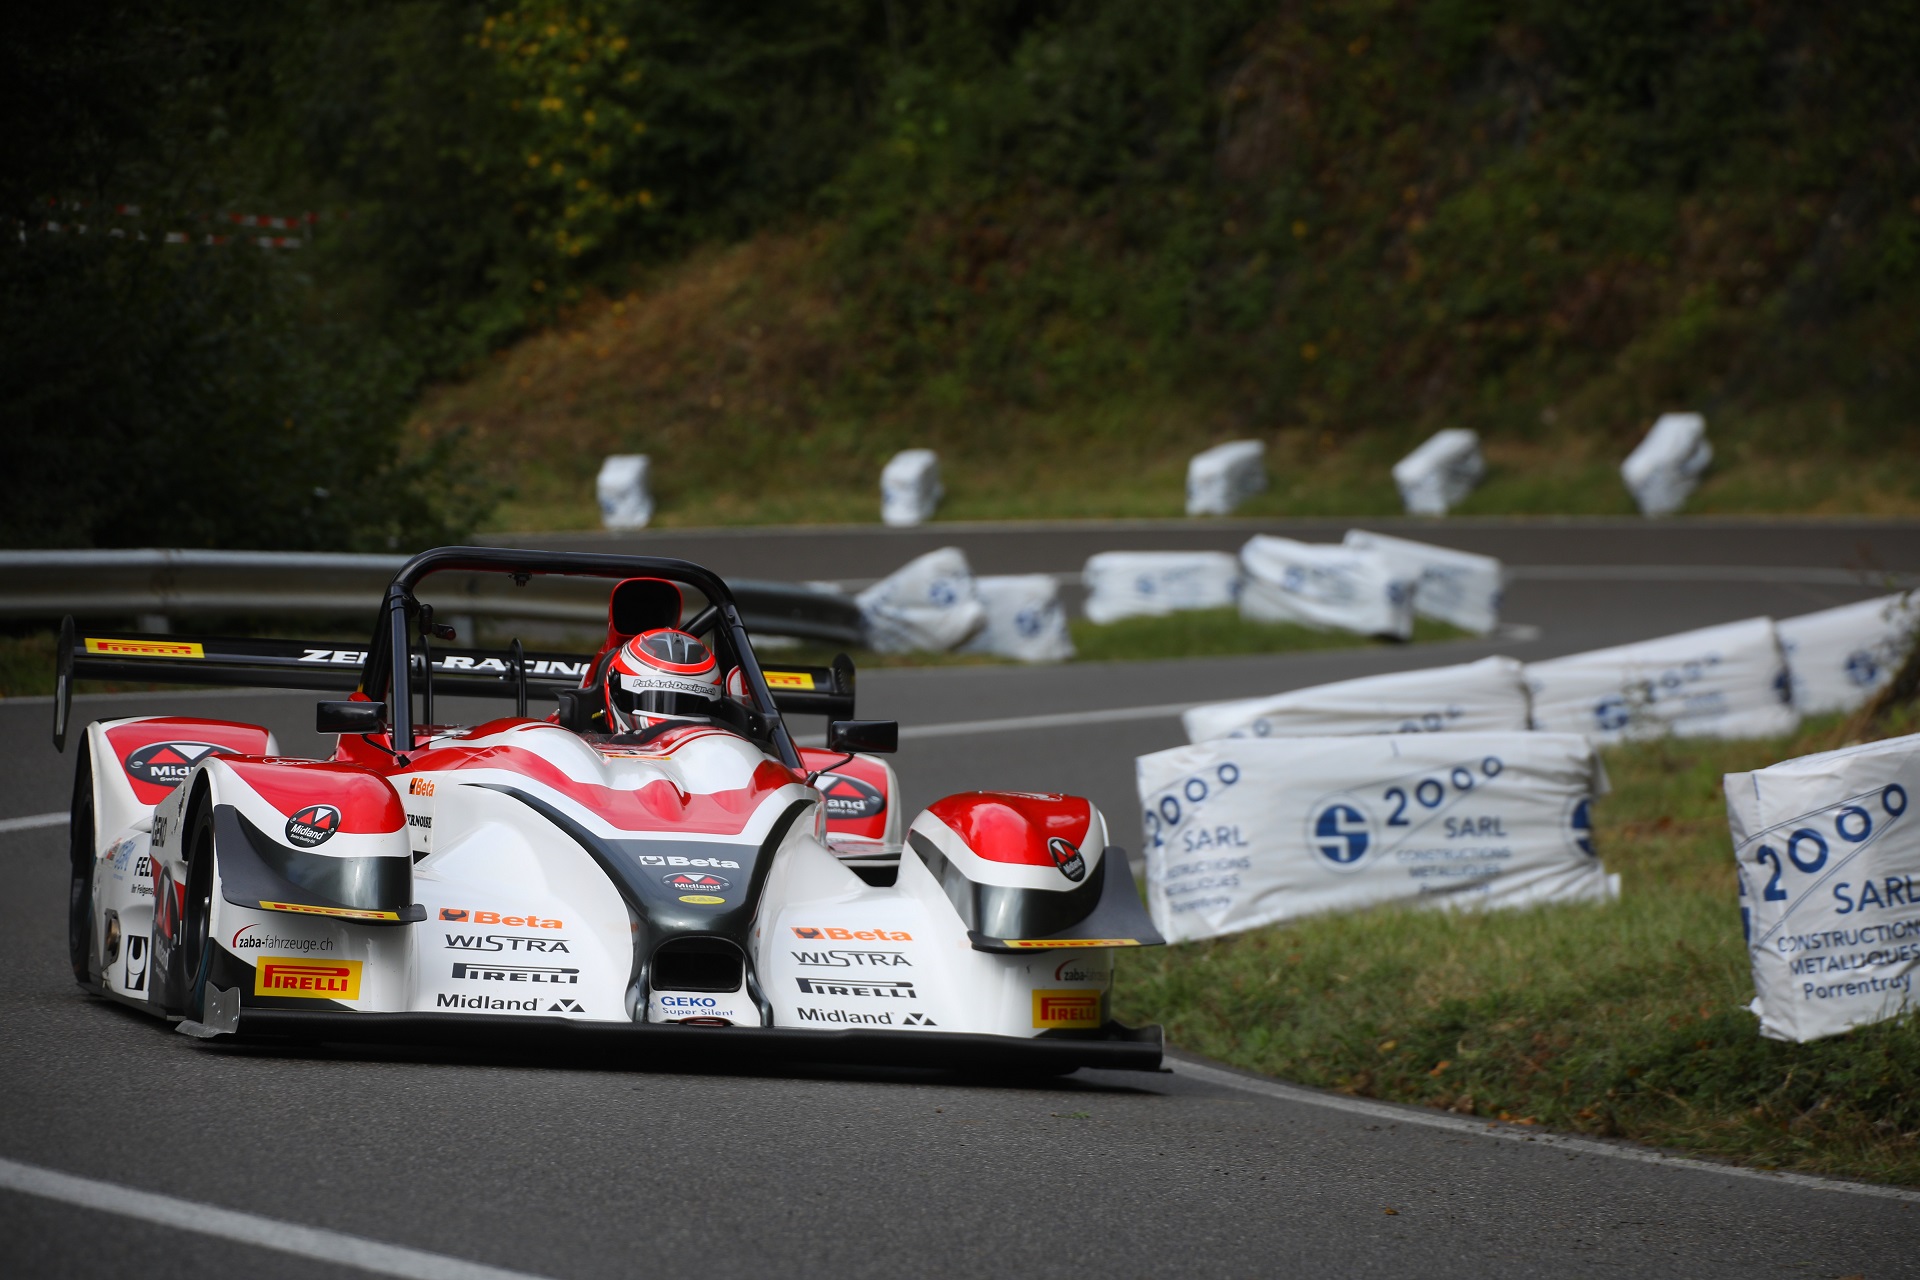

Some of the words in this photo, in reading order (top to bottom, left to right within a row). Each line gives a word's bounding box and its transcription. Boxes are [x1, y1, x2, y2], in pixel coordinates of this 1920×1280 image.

[416, 777, 435, 797] Beta
[1384, 756, 1503, 826] 2000
[290, 823, 325, 840] Midland
[1444, 816, 1508, 838] SARL
[1184, 825, 1248, 852] SARL
[1757, 783, 1907, 901] 2000
[667, 856, 740, 869] Beta
[1833, 876, 1920, 915] SARL
[474, 911, 563, 929] Beta
[239, 934, 334, 954] zaba-fahrzeuge.ch
[444, 934, 570, 954] WISTRA
[823, 927, 914, 941] Beta
[1777, 919, 1920, 953] CONSTRUCTION
[791, 950, 914, 967] WISTRA
[263, 965, 351, 992] PIRELLI
[452, 963, 580, 984] PIRELLI
[795, 977, 917, 998] PIRELLI
[1803, 973, 1911, 1001] Porrentruy
[437, 993, 538, 1011] Midland
[661, 996, 716, 1007] GEKO
[662, 1007, 697, 1016] Super
[797, 1007, 892, 1025] Midland
